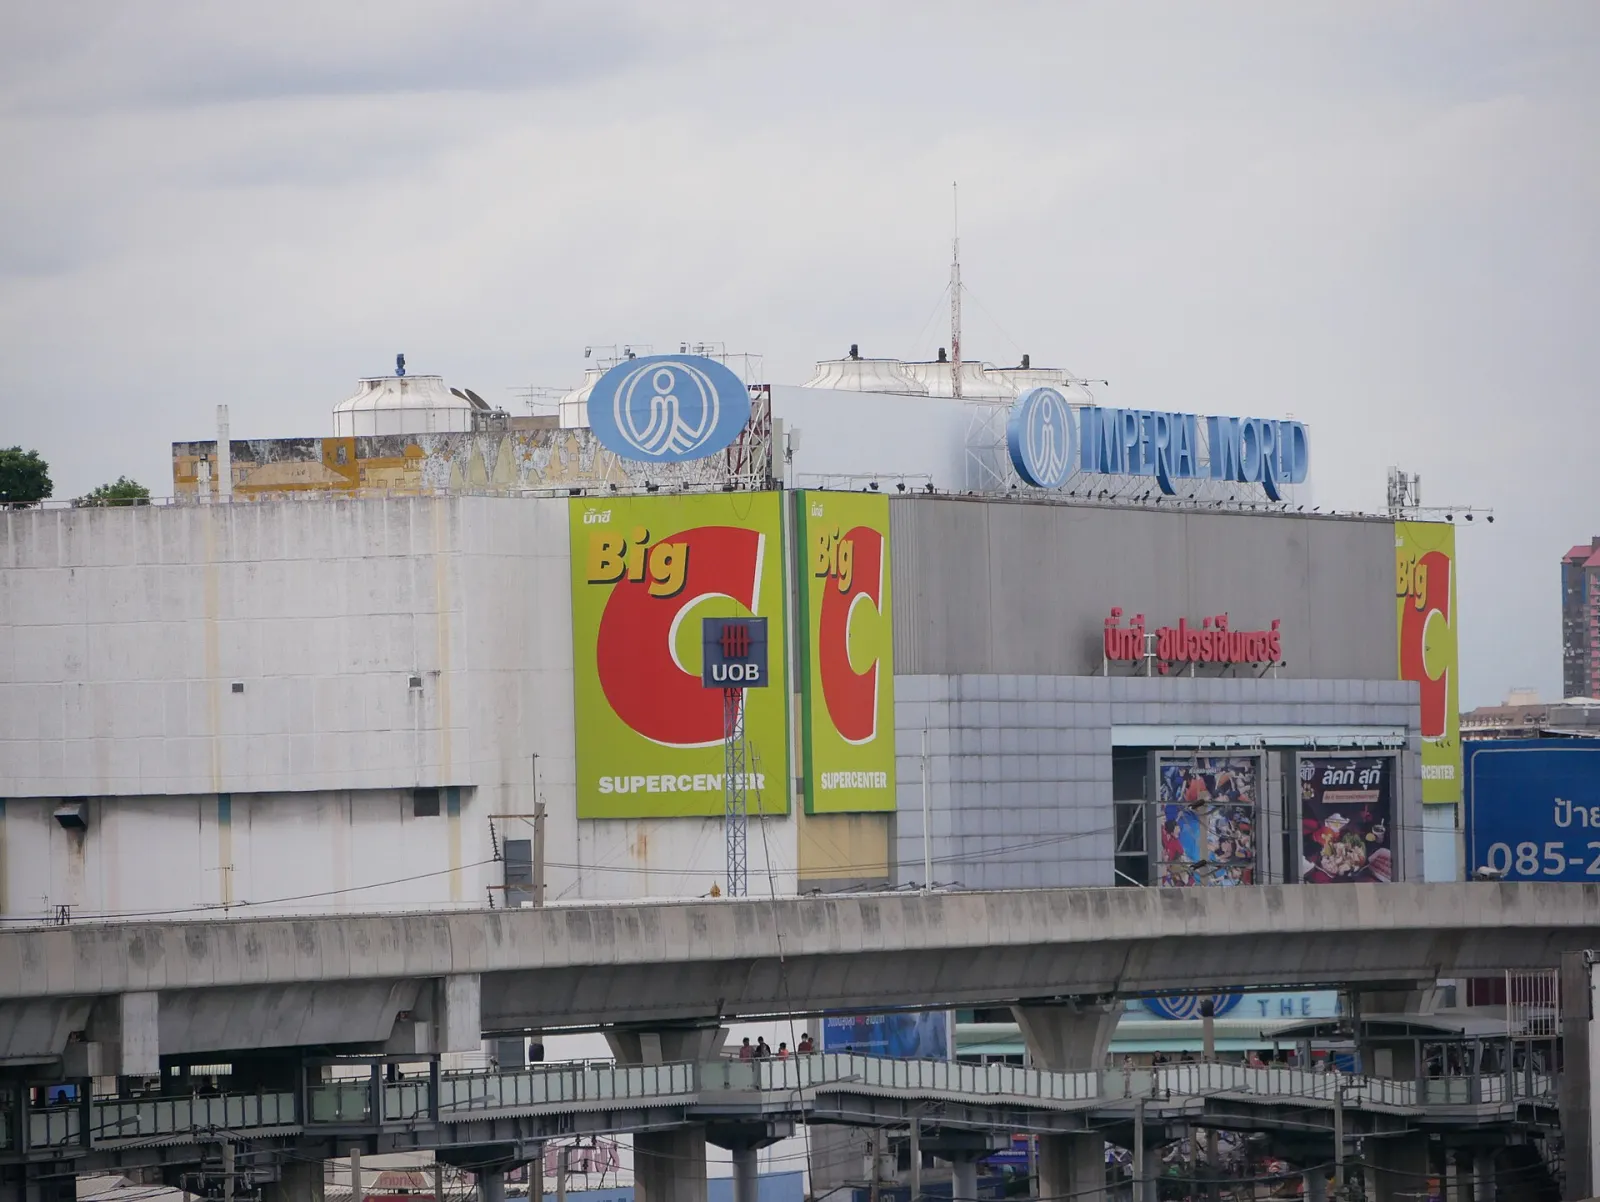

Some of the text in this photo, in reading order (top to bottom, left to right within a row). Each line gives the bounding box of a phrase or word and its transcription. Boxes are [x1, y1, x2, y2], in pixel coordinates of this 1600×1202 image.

[1080, 406, 1309, 501] IMPERIAL WORLD
[583, 508, 611, 524] บิ๊กซี
[1395, 549, 1428, 612] Big
[586, 524, 766, 749] Big C
[814, 522, 885, 746] Big C
[1104, 606, 1145, 661] บิ๊กซี
[712, 664, 760, 681] UOB
[598, 773, 765, 794] SUPERCENTER
[821, 771, 887, 790] SUPERCENTER
[1322, 760, 1357, 785] ลัคกี้
[1358, 759, 1383, 791] สุกี้
[1257, 997, 1311, 1017] THE
